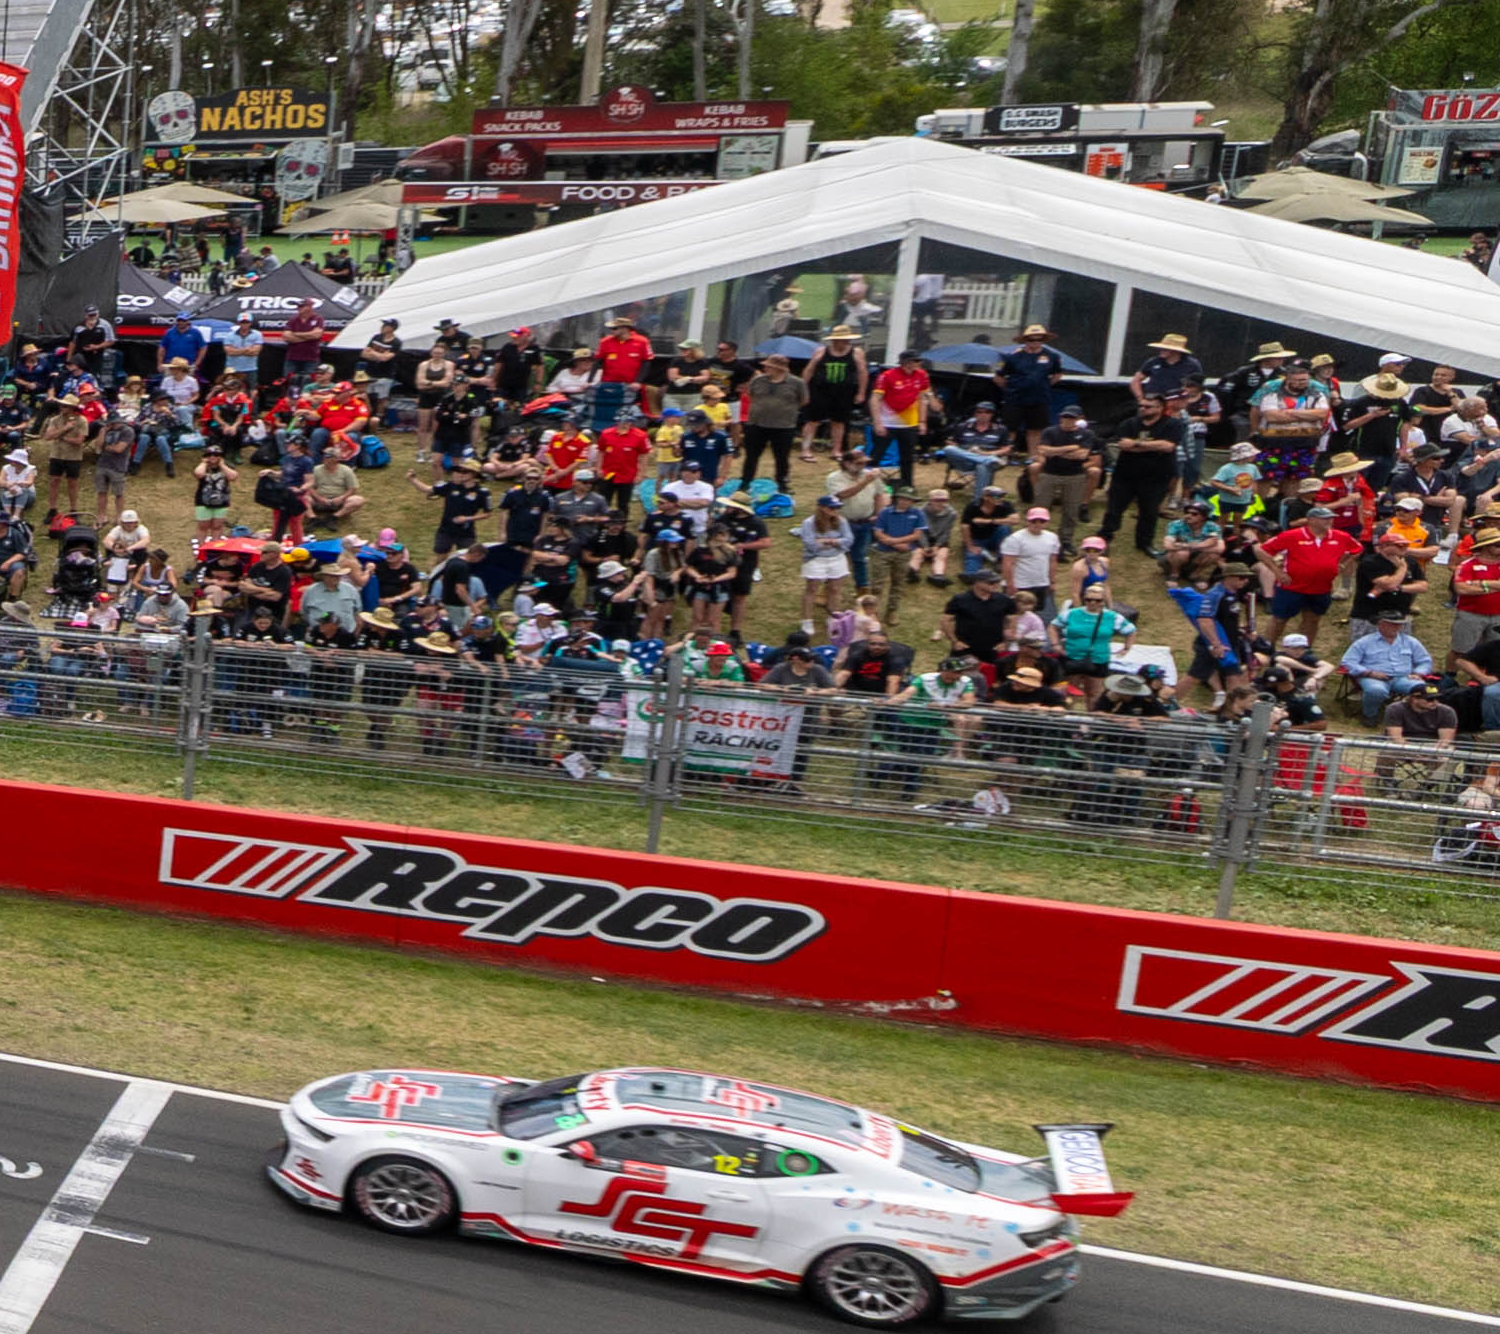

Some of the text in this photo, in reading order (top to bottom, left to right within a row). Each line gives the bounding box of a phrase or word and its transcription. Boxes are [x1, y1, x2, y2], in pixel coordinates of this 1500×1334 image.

[236, 89, 293, 107] ASH'S
[201, 104, 327, 132] NACHOS
[504, 110, 544, 122] KEBAB
[703, 104, 746, 116] KEBAB
[525, 121, 562, 132] PACKS
[675, 117, 720, 130] WRAPS
[733, 115, 769, 127] FRIES
[562, 185, 635, 201] FOOD
[640, 186, 660, 200] &
[678, 703, 791, 732] Castrol
[692, 730, 782, 752] RACING
[297, 835, 828, 965] Repco
[713, 1154, 742, 1175] 12
[555, 1228, 681, 1257] LOGISTICS
